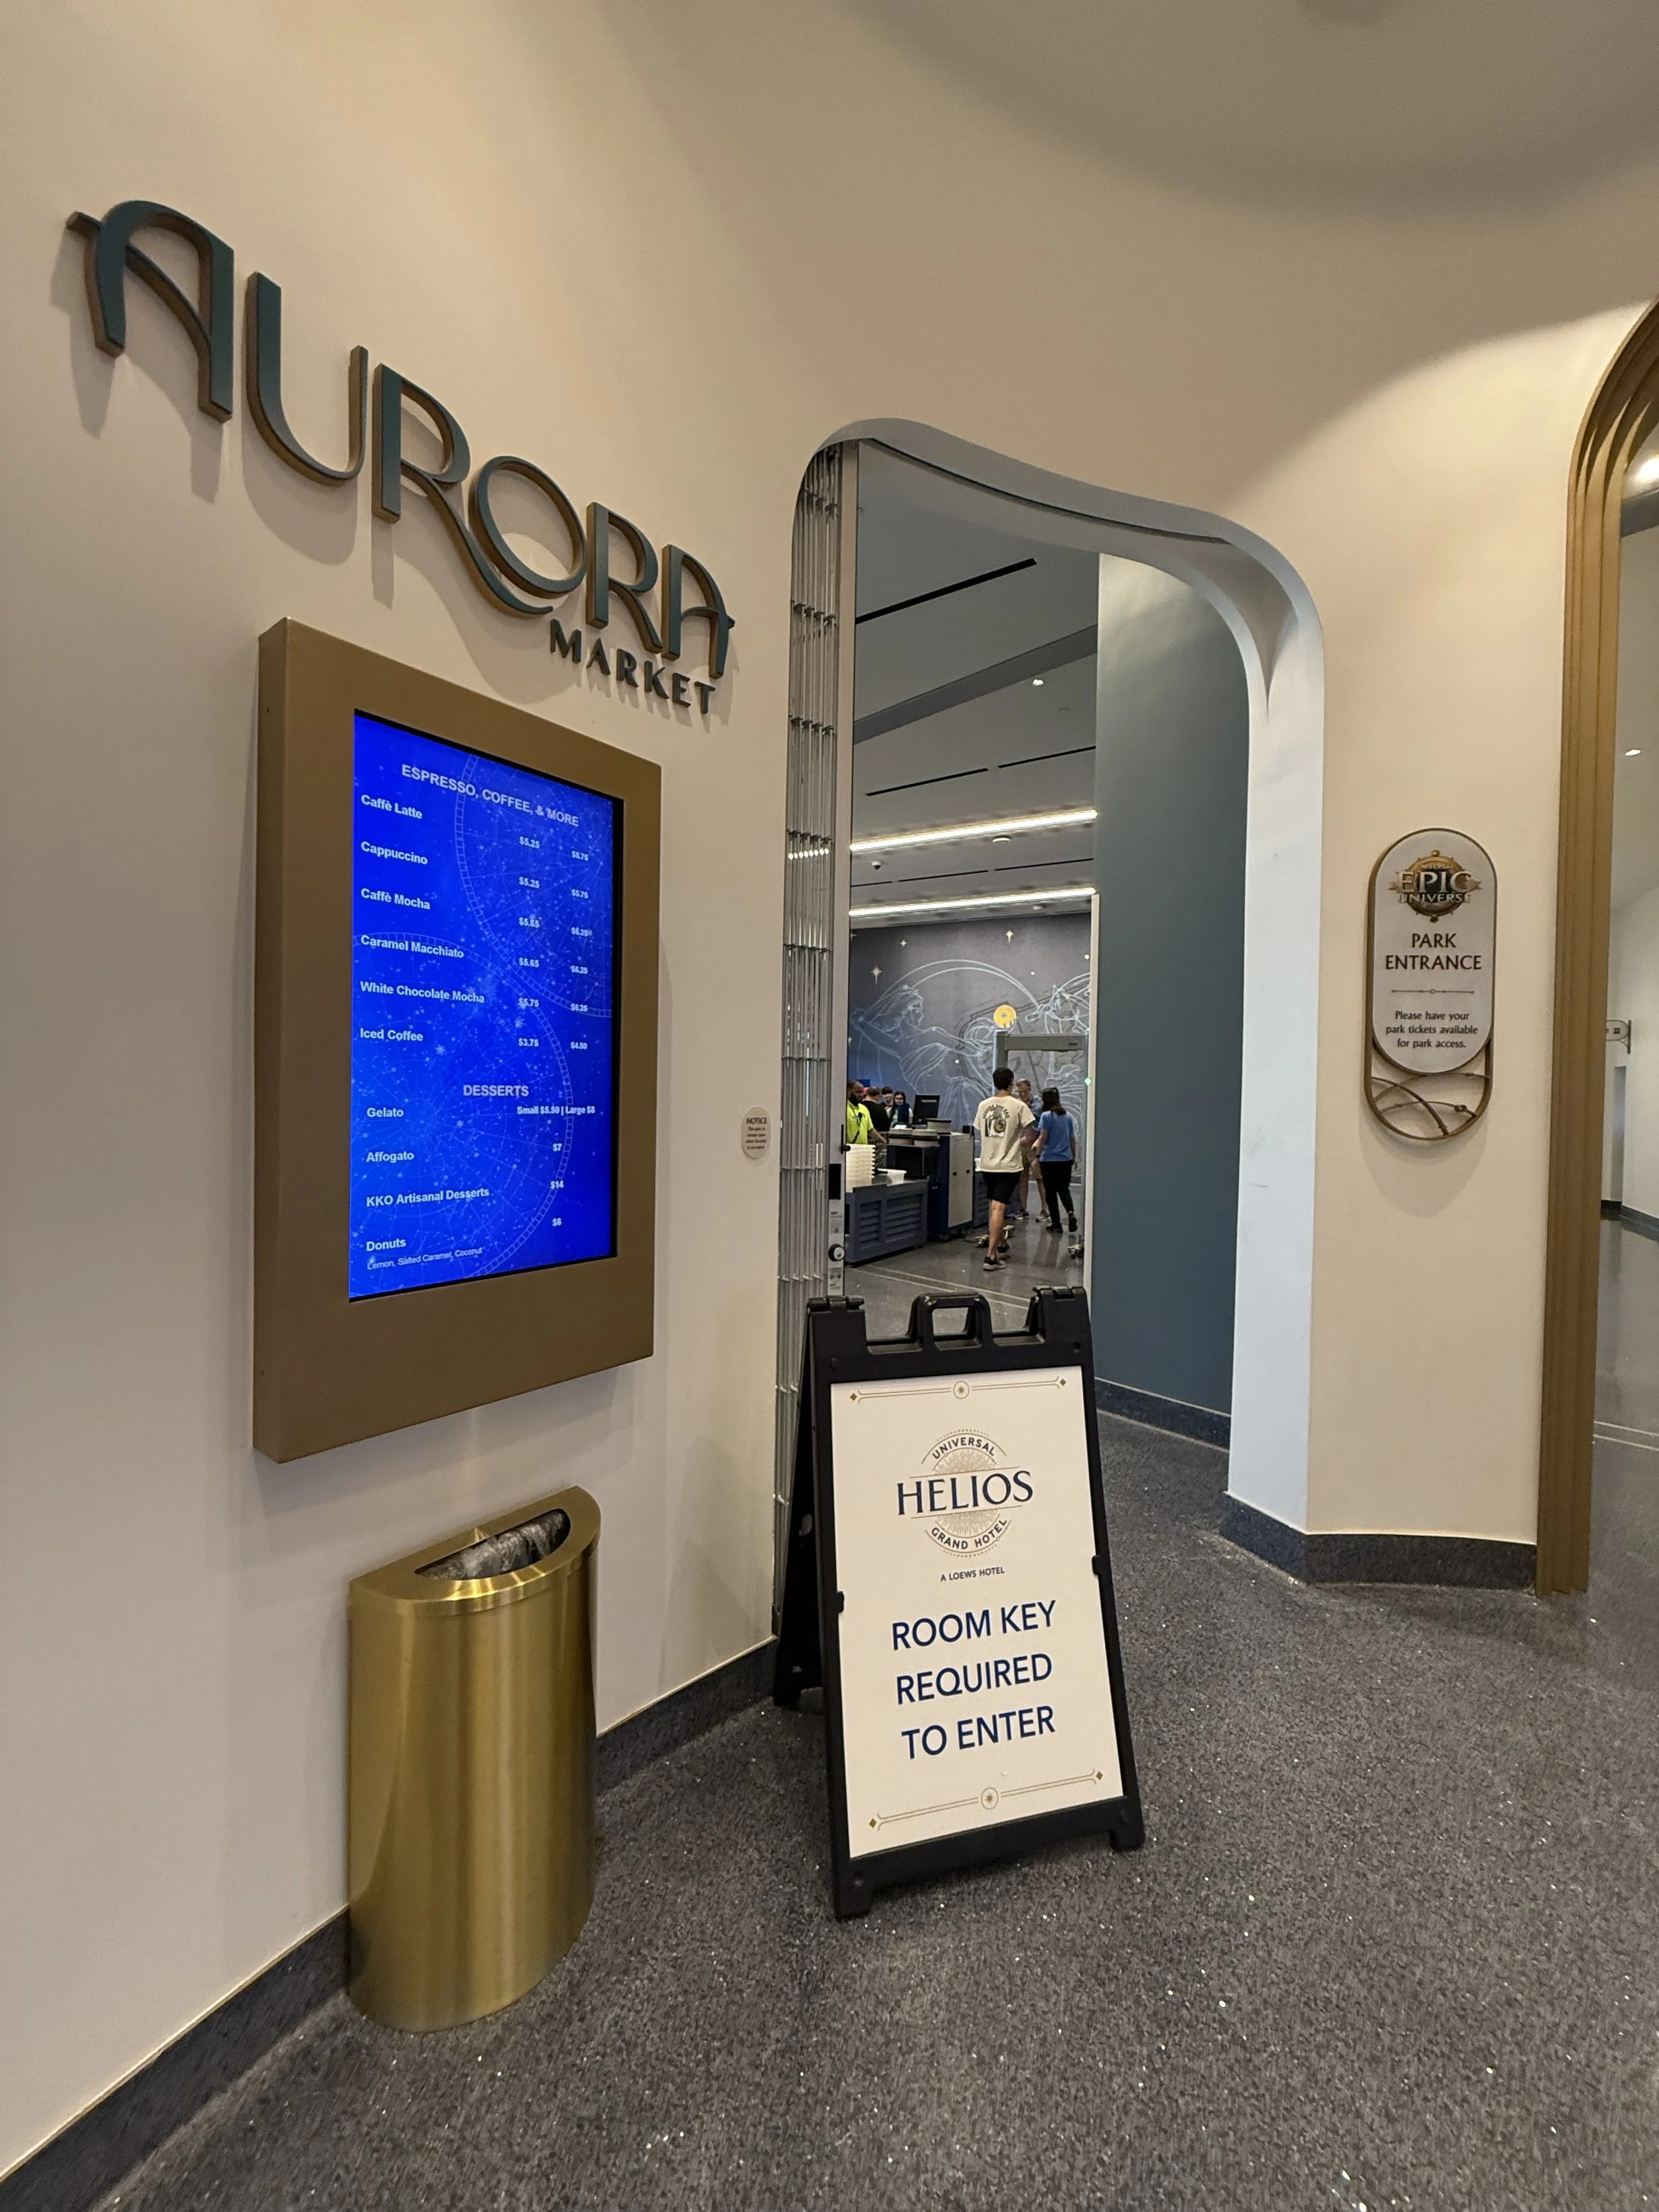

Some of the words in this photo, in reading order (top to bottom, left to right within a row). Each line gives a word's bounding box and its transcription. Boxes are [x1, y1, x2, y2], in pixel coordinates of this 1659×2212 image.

[66, 199, 735, 680] AURORA
[550, 618, 715, 715] MARKET
[401, 765, 479, 796] ESPRESSO,
[482, 788, 534, 814] COFFEE,
[536, 805, 544, 816] &
[546, 808, 579, 827] MORE
[361, 795, 392, 812] Caffè
[395, 802, 423, 820] Latte
[519, 836, 540, 849] $5.25
[361, 842, 428, 865] Cappuccino
[571, 850, 589, 862] $5.75
[519, 876, 540, 889] $5.25
[1396, 871, 1472, 893] EPIC
[361, 888, 392, 903] Caffè
[395, 894, 430, 911] Mocha
[571, 888, 589, 899] $5.75
[1399, 893, 1471, 903] UNIVERSE
[361, 935, 409, 951] Caramel
[411, 942, 465, 959] Macchiato
[1411, 933, 1457, 948] PARK
[519, 957, 540, 968] $5.65
[1386, 955, 1482, 970] ENTRANCE
[571, 965, 589, 975] $6.25
[360, 981, 394, 994] White
[397, 985, 451, 999] Chocolate
[453, 990, 485, 1003] Mocha
[518, 997, 540, 1008] $5.75
[571, 1003, 589, 1013] $6.25
[1395, 1010, 1422, 1020] Please
[1425, 1011, 1446, 1021] have
[1449, 1012, 1469, 1023] your
[360, 1028, 384, 1041] Iced
[387, 1031, 423, 1042] Coffee
[1386, 1025, 1406, 1035] park
[1408, 1025, 1437, 1034] tickets
[1439, 1025, 1478, 1035] available
[518, 1037, 539, 1047] $3.75
[1398, 1039, 1410, 1048] for
[1413, 1039, 1433, 1049] park
[463, 1084, 529, 1096] DESSERTS
[366, 1108, 404, 1118] Gelato
[517, 1106, 539, 1115] Small
[540, 1106, 560, 1115] $5.50
[565, 1106, 585, 1116] Large
[587, 1106, 595, 1114] $8
[553, 1143, 562, 1152] $7
[366, 1151, 415, 1163] Affogato
[550, 1181, 564, 1190] $14
[366, 1195, 394, 1207] KKO
[396, 1191, 443, 1204] Artisanal
[446, 1188, 490, 1200] Desserts
[552, 1218, 562, 1226] $6
[366, 1238, 407, 1252] Donuts
[367, 1258, 396, 1270] Lemon,
[398, 1254, 421, 1266] Salted
[423, 1251, 453, 1262] Caramel,
[455, 1247, 482, 1258] Coconut
[932, 1438, 996, 1459] UNIVERSAL
[897, 1470, 1033, 1514] HELIOS
[931, 1526, 969, 1550] GRAND
[974, 1518, 1008, 1548] HOTEL
[949, 1570, 977, 1581] LOEWS
[979, 1566, 1005, 1576] HOTEL
[893, 1610, 991, 1651] ROOM
[1001, 1599, 1056, 1634] KEY
[897, 1653, 1052, 1705] REQUIRED
[901, 1725, 947, 1759] TO
[958, 1705, 1056, 1750] ENTER
